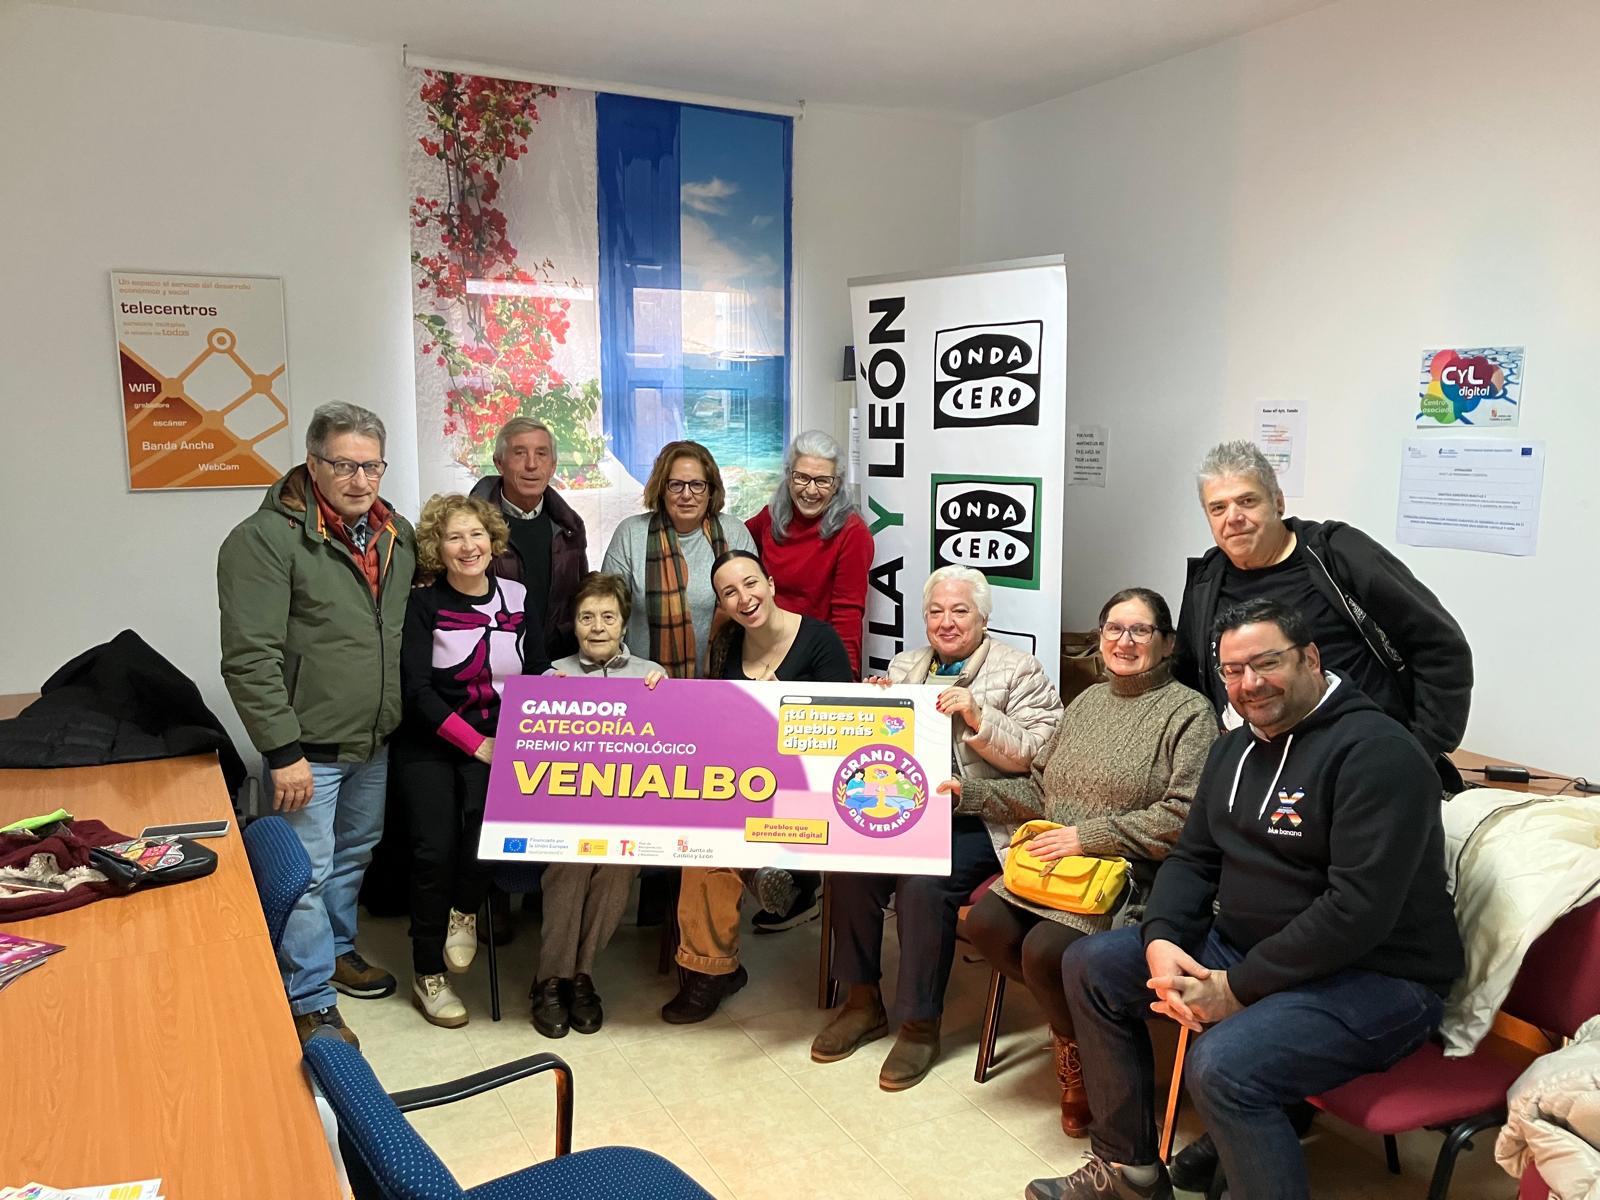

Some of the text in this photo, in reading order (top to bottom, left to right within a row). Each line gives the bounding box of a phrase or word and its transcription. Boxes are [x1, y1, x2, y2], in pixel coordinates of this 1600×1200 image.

[121, 301, 217, 316] telecentros
[948, 345, 1023, 370] ONDA
[129, 383, 156, 393] WIFI
[1458, 385, 1490, 399] digital
[953, 386, 1022, 410] CERO
[153, 419, 187, 427] escáner
[142, 441, 214, 451] Banda Ancha
[198, 463, 240, 471] WebCam
[860, 297, 906, 679] LLA Y LEÓN
[948, 501, 1017, 521] ONDA
[952, 537, 1017, 561] CERO
[521, 700, 628, 717] GANADOR
[811, 709, 855, 722] haces
[858, 711, 875, 722] tu
[519, 718, 655, 736] CATEGORÍA A
[784, 723, 874, 736] pueblo más
[516, 739, 697, 755] PREMIO KIT TECNOLÓGICO
[783, 737, 838, 752] digital!
[841, 750, 923, 783] GRAND TIC
[512, 760, 778, 802] VENIALBO
[849, 808, 911, 832] DEL VERANO
[799, 831, 823, 839] digital
[1279, 828, 1302, 837] banana
